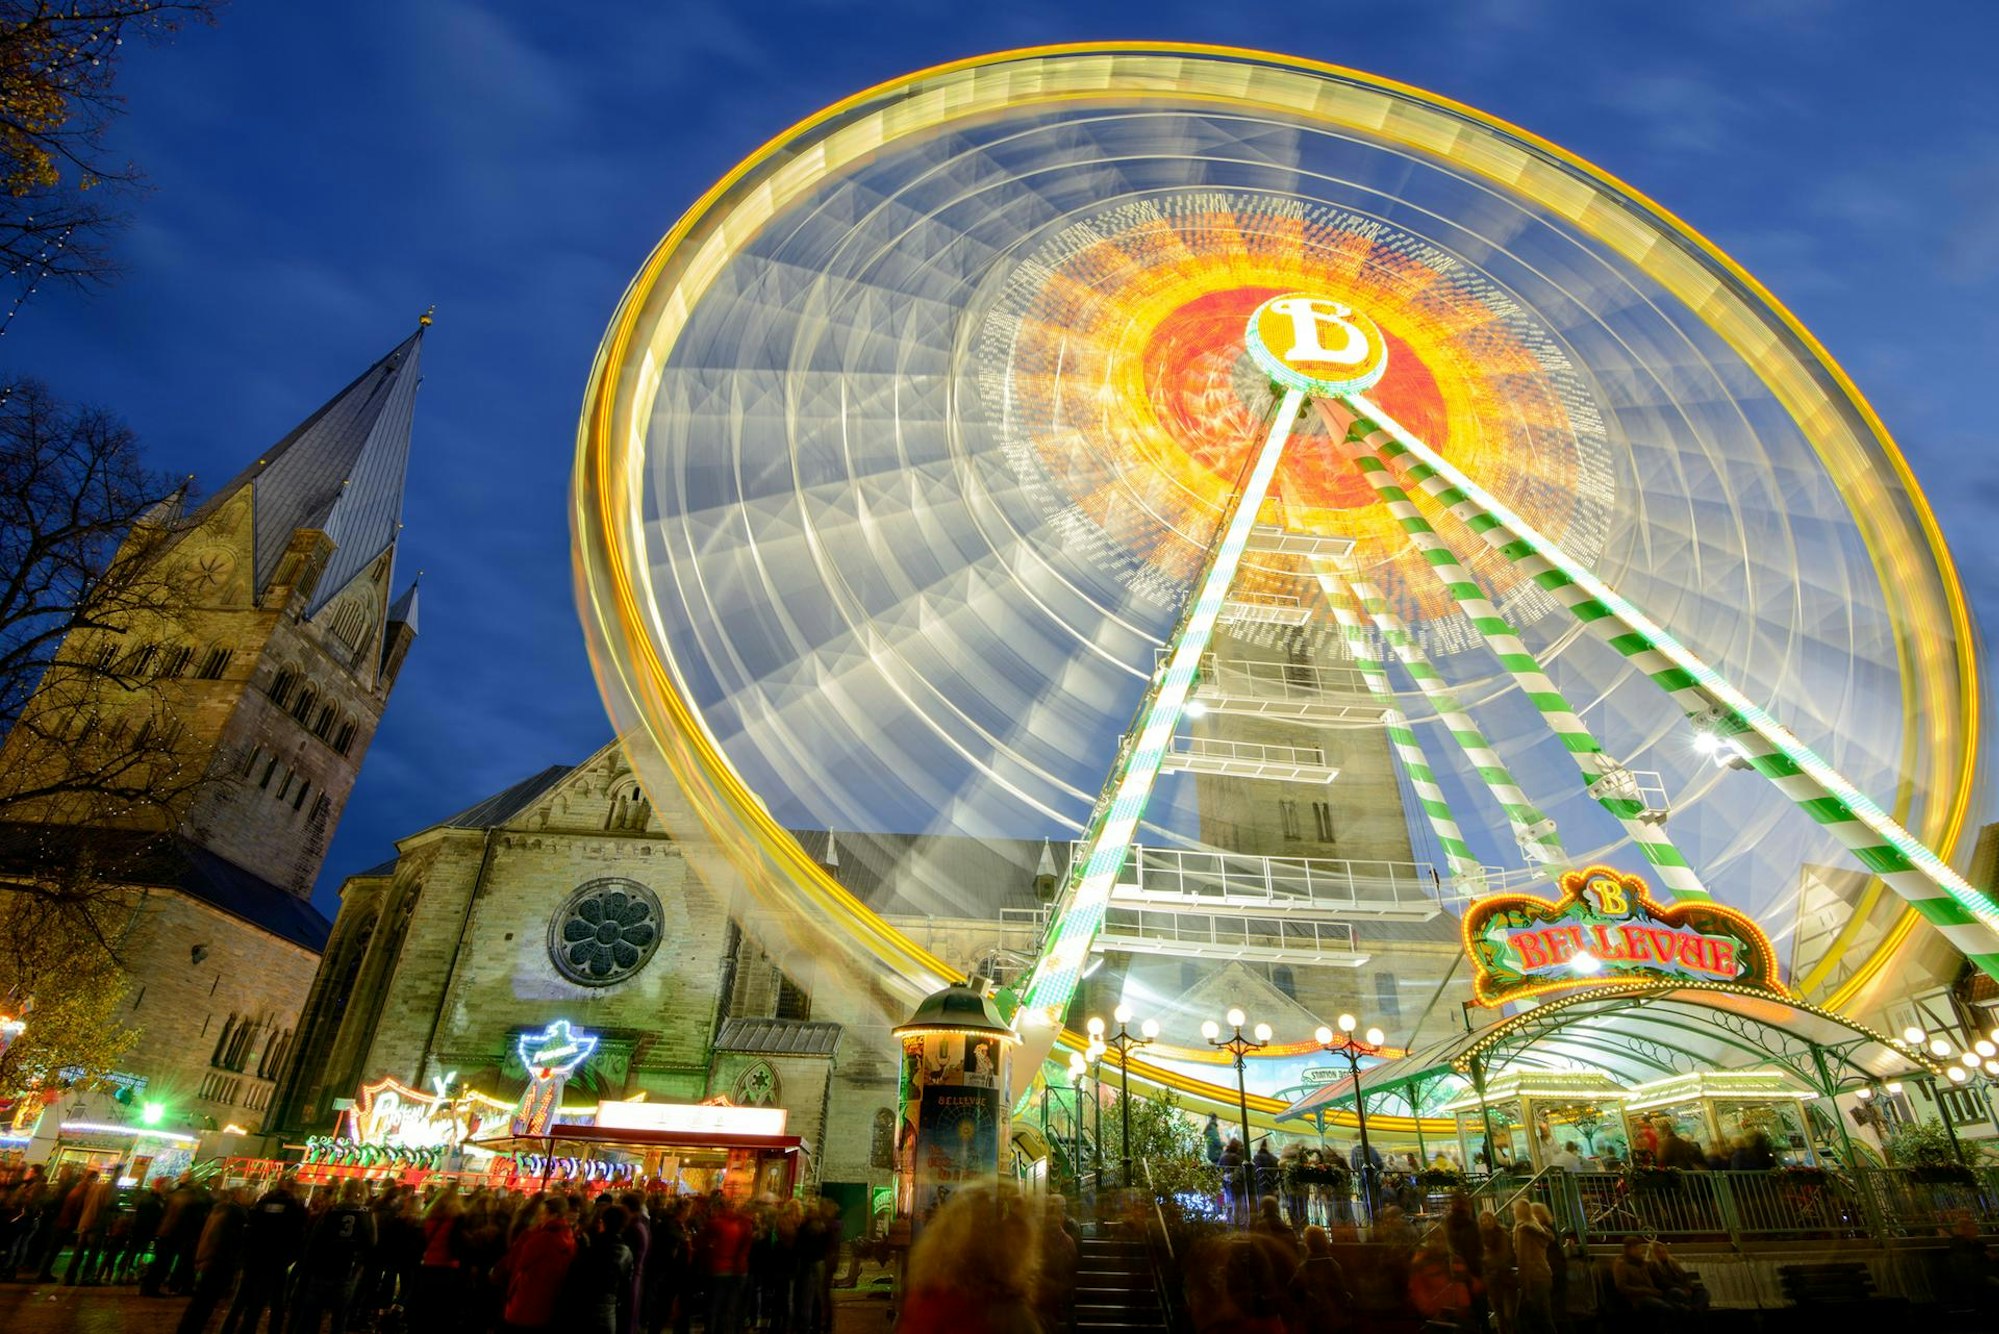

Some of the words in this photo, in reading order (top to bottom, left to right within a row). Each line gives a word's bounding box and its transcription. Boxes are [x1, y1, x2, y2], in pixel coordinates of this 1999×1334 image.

[1270, 298, 1369, 365] B
[1593, 880, 1628, 915] B
[1509, 925, 1737, 976] BELLEVUE
[1311, 1070, 1337, 1079] STATION
[938, 1096, 986, 1106] BELLEVUE
[339, 1214, 356, 1238] 3
